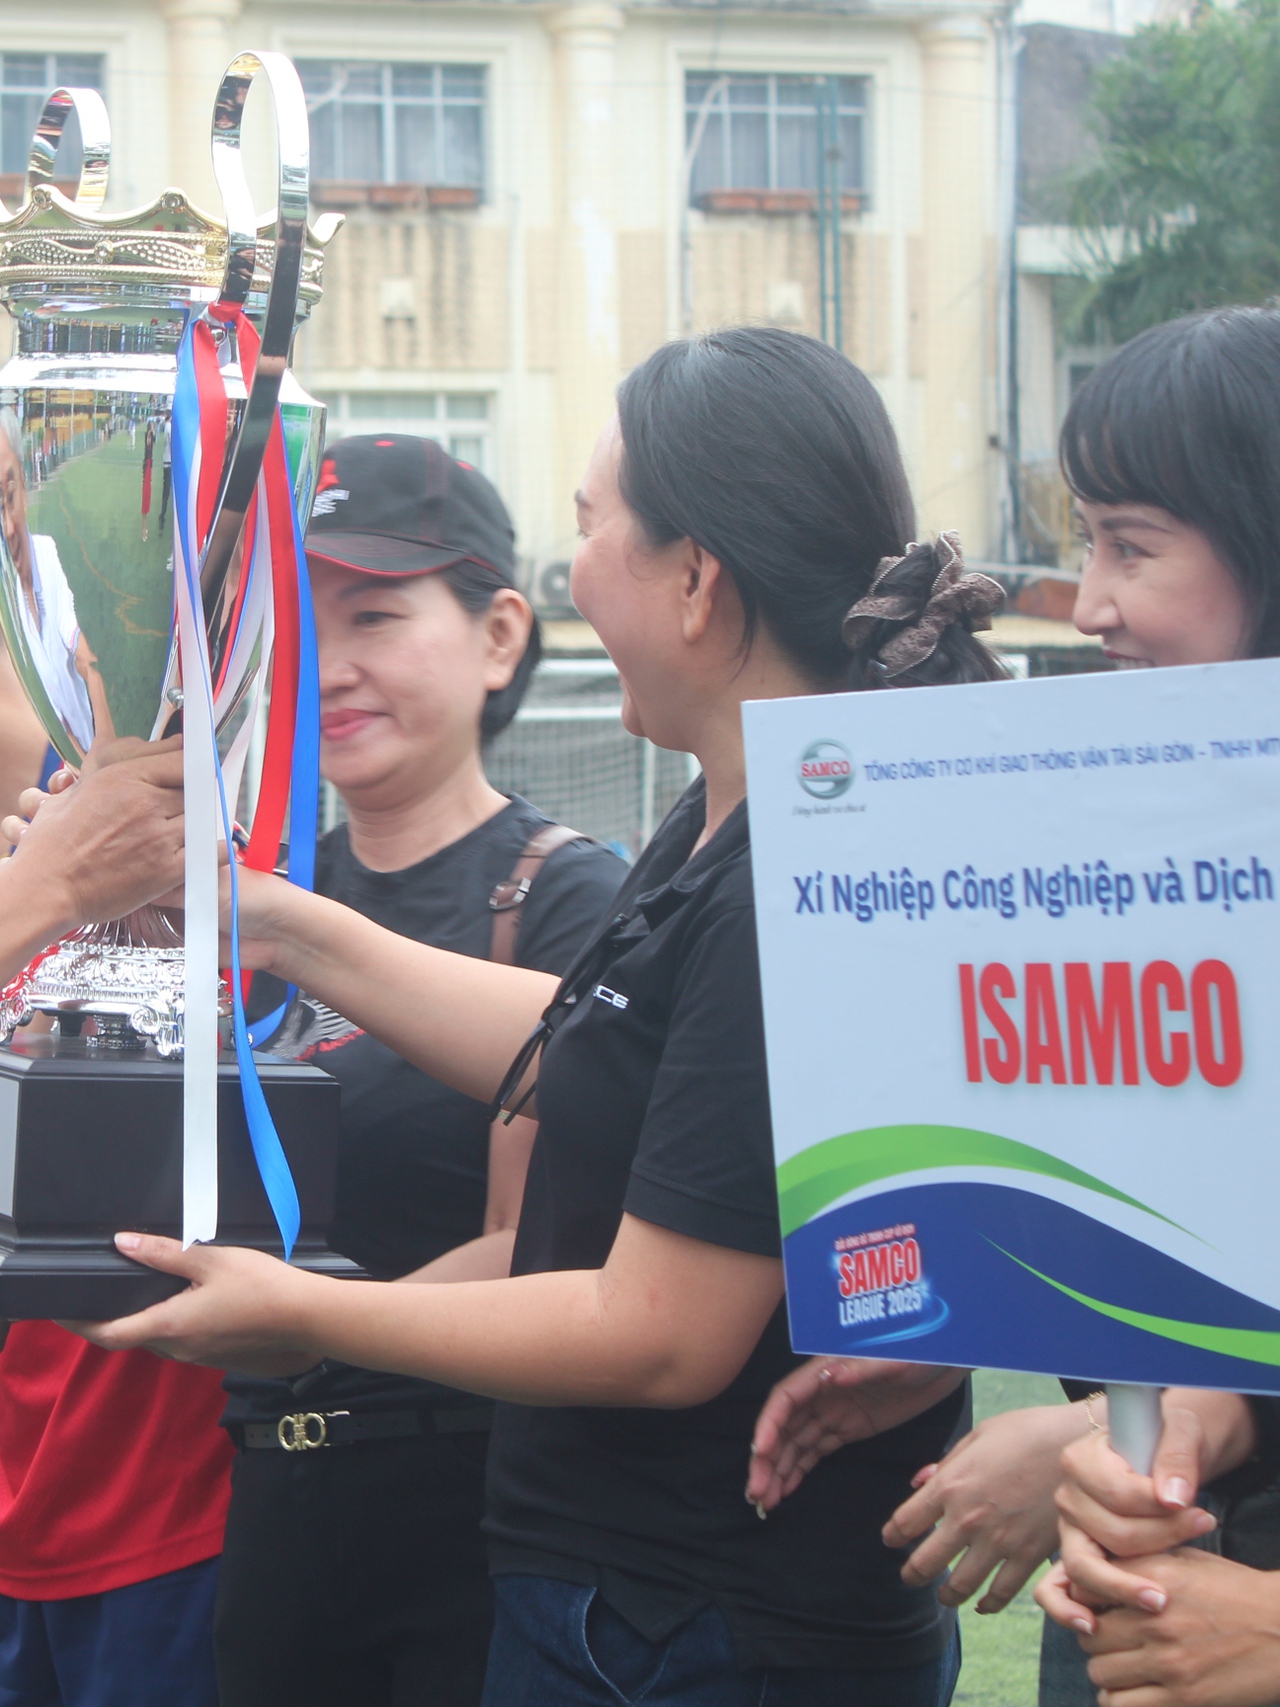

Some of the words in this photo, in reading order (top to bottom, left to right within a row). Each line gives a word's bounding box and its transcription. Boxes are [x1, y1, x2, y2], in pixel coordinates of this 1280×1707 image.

[801, 760, 851, 778] SAMCO
[900, 758, 936, 780] CÔNG
[937, 759, 953, 777] TY
[975, 752, 996, 775] KHÍ
[999, 752, 1029, 774] GIAO
[1031, 749, 1077, 771] THÔNG
[1209, 741, 1251, 760] TNHH
[793, 870, 824, 915] Xí
[831, 866, 935, 923] Nghiệp
[943, 864, 1017, 919] Công
[1022, 859, 1134, 918] Nghiệp
[1142, 856, 1186, 904] và
[1193, 855, 1275, 913] Dịch
[593, 984, 629, 1009] CE
[957, 958, 1244, 1088] ISAMCO
[838, 1237, 921, 1299] SAMCO
[839, 1293, 887, 1327] LEAGUE
[887, 1286, 923, 1316] 2025
